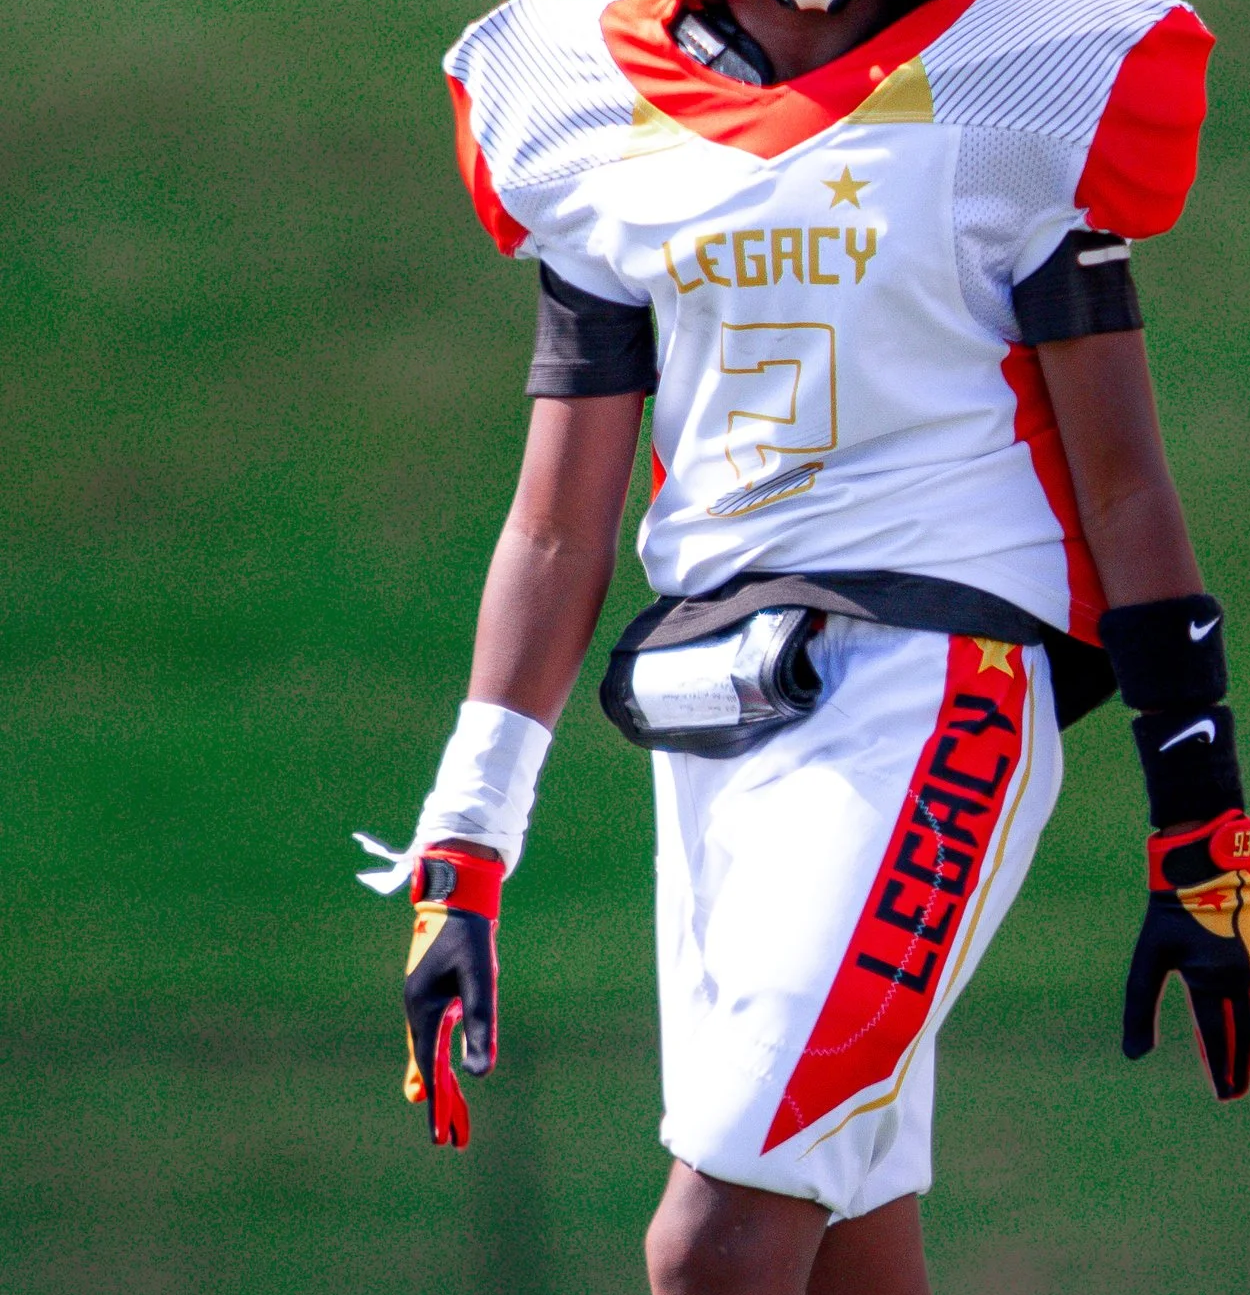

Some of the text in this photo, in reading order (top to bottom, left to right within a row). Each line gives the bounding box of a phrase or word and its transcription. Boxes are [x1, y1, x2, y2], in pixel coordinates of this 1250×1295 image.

[663, 227, 878, 294] LEGACY
[706, 321, 838, 517] 2
[856, 693, 1016, 994] LEGACY
